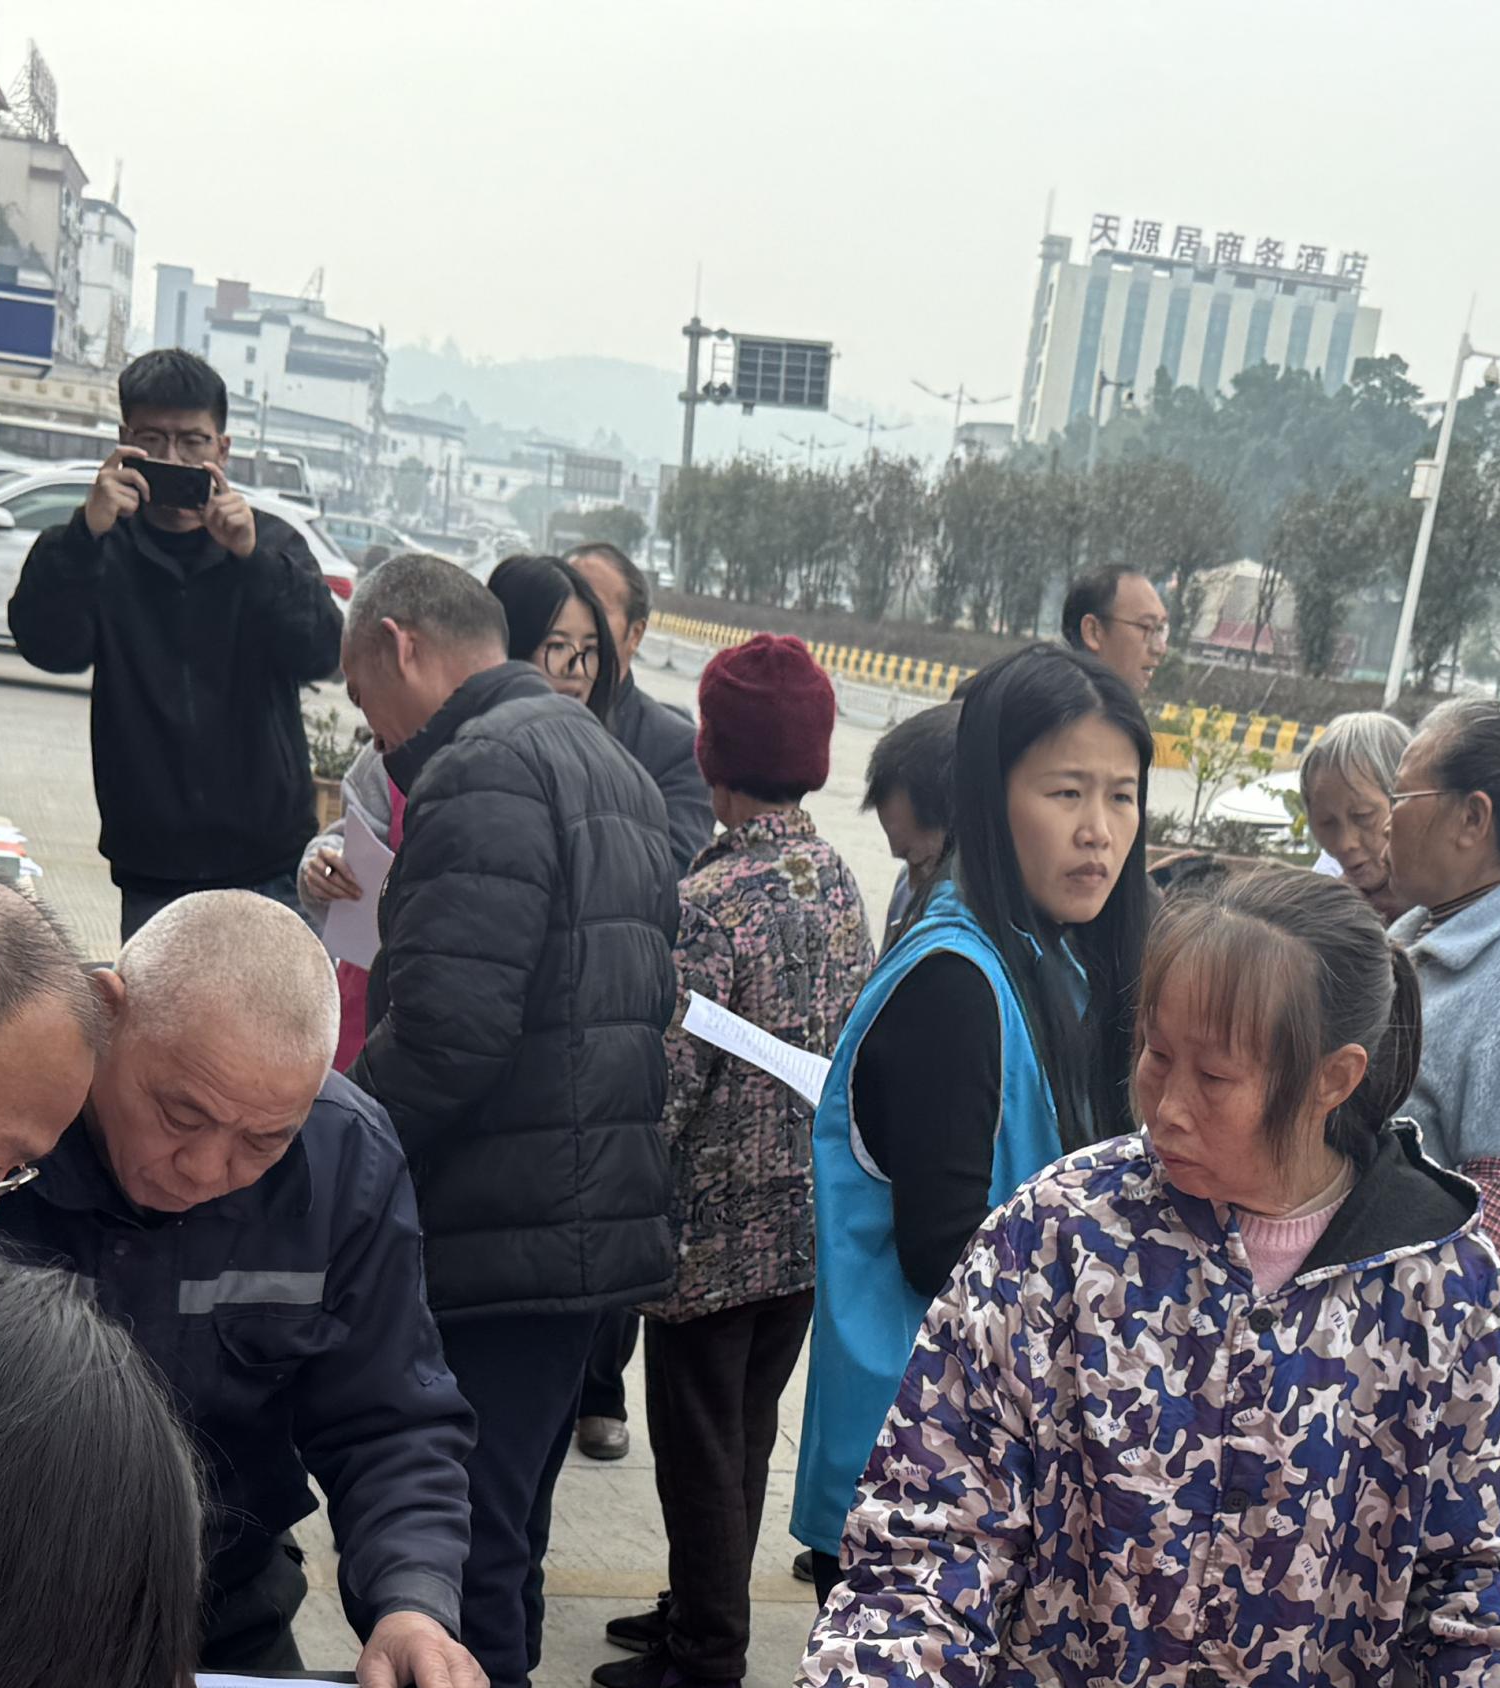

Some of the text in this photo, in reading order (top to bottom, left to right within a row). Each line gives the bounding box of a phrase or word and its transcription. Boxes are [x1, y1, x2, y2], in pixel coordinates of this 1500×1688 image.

[1090, 214, 1368, 285] 天源居商务酒店
